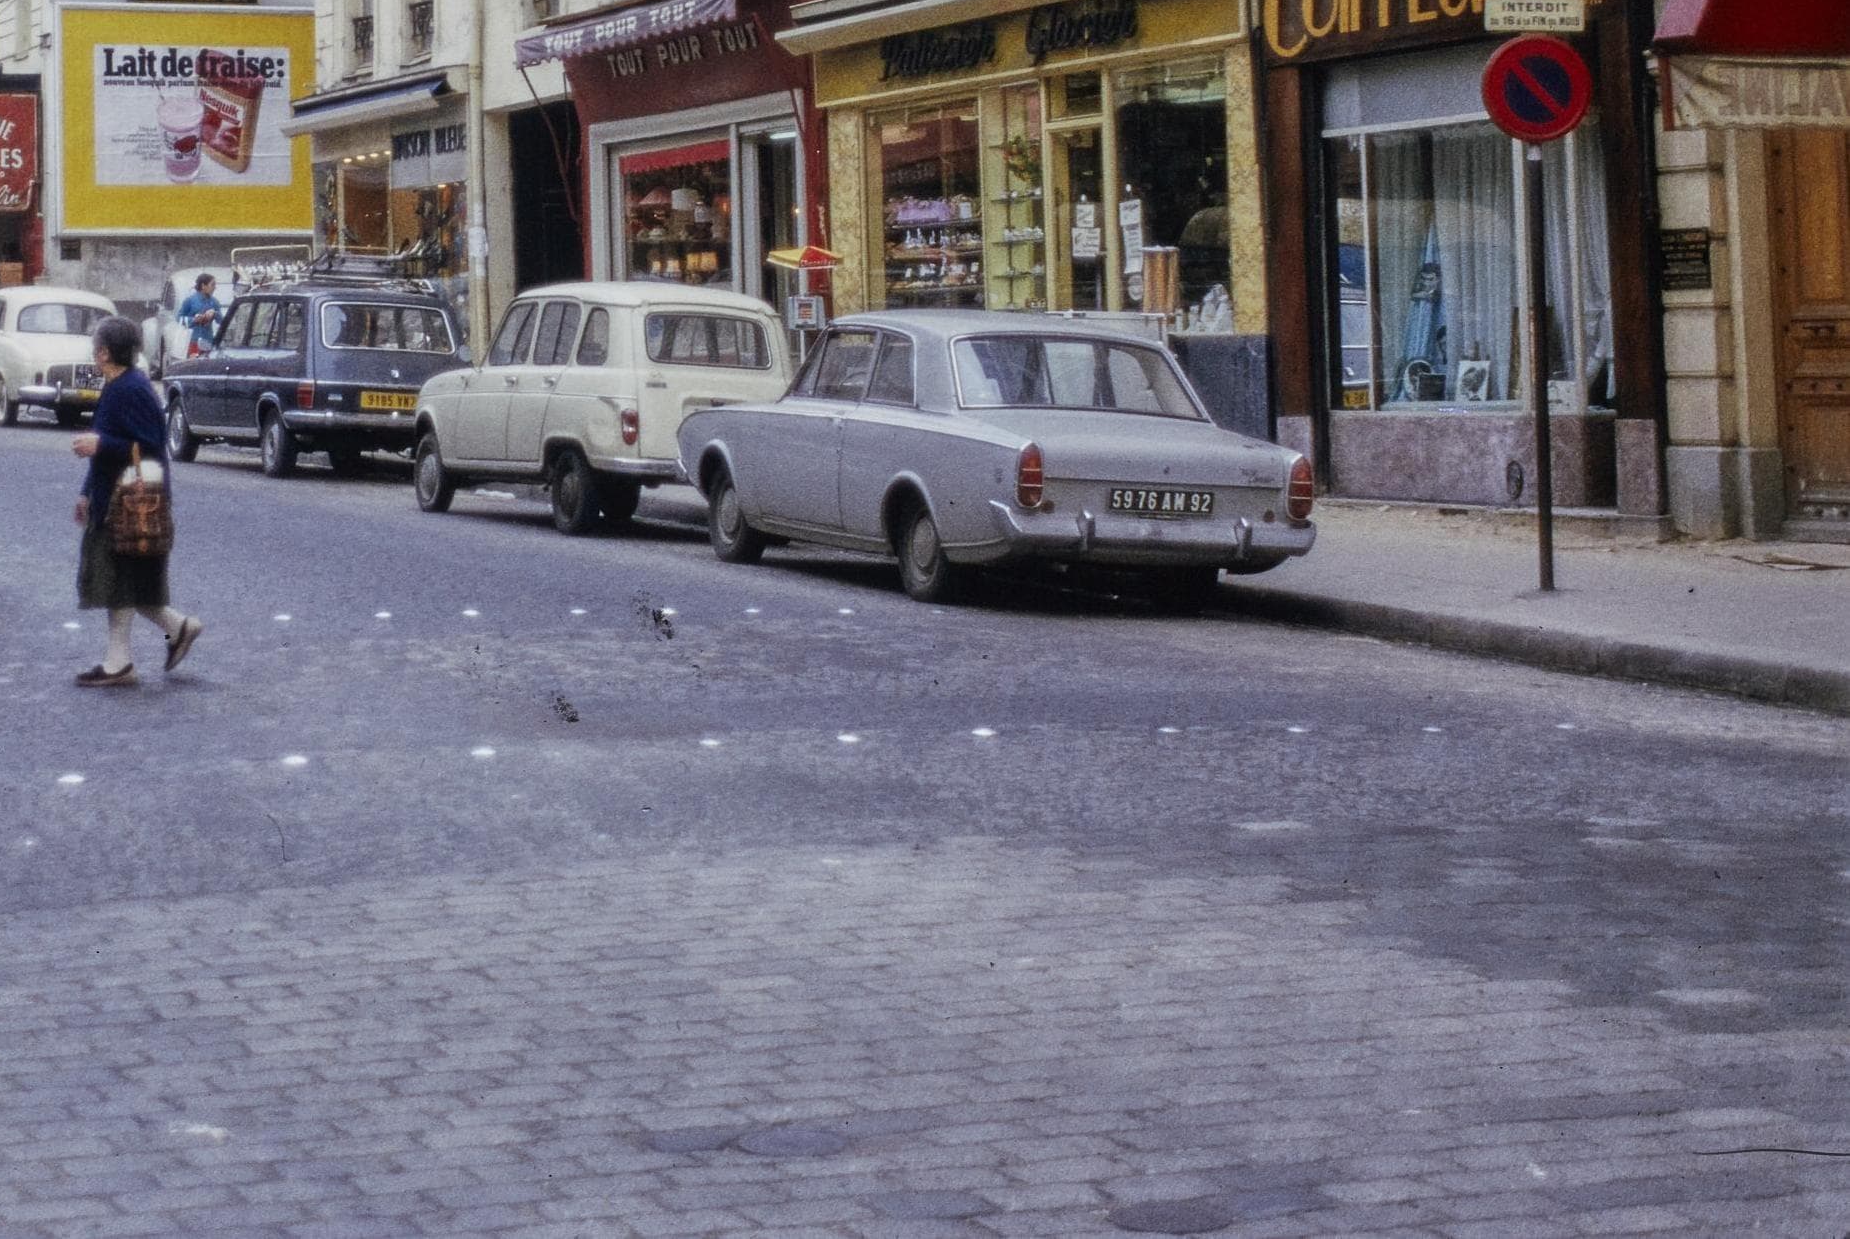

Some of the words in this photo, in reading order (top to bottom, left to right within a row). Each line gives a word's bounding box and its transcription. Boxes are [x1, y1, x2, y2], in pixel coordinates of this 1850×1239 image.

[1502, 2, 1568, 12] INTERDIT
[545, 30, 584, 52] TOUT
[595, 16, 637, 42] POUR
[650, 2, 696, 27] TOUT
[103, 47, 157, 77] Lait
[161, 47, 194, 78] de
[198, 48, 285, 79] fraise:
[607, 48, 644, 78] TOUT
[658, 38, 702, 68] POUR
[715, 23, 759, 54] TOUT
[200, 88, 241, 119] Nesquik
[1162, 492, 1184, 511] AM
[1190, 493, 1211, 512] 92
